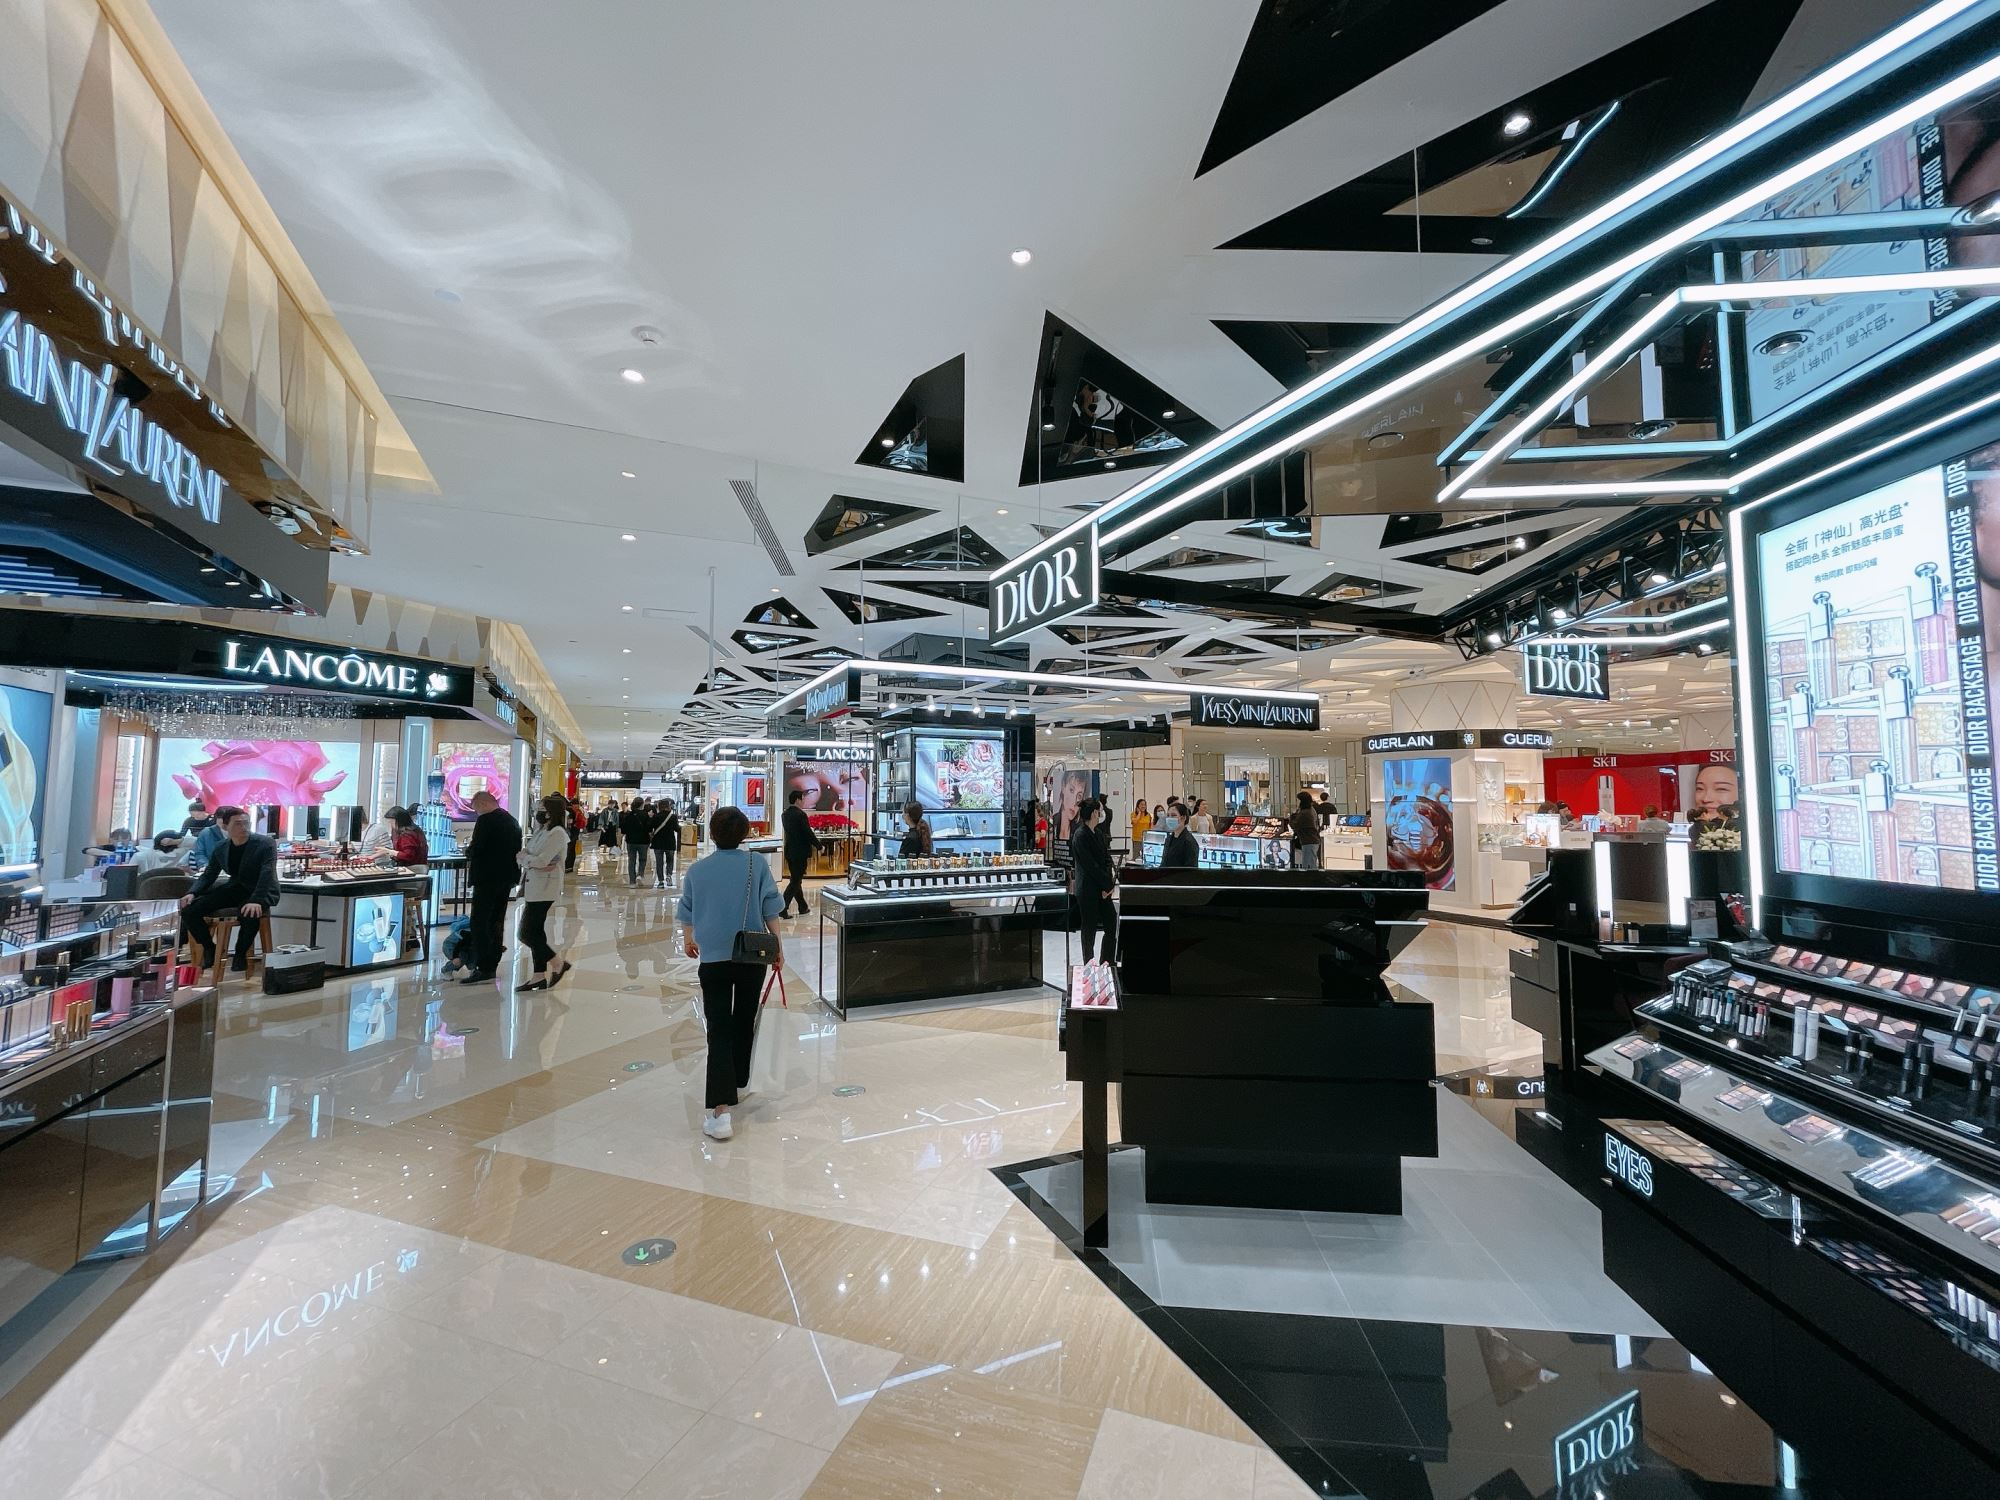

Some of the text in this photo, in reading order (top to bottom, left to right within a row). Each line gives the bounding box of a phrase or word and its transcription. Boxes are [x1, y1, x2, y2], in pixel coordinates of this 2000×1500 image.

[1946, 460, 1969, 498] DIOR
[995, 547, 1082, 633] DIOR
[1949, 505, 1979, 626] DIOR BACKSTAGE
[224, 641, 417, 693] LANCÔME
[1536, 657, 1604, 695] DIOR
[1959, 635, 1989, 755] DIOR BACKSTAGE
[1368, 735, 1434, 750] GUERLAIN
[1593, 757, 1617, 768] SK-II
[586, 771, 624, 780] CHANEL
[1970, 767, 2000, 889] DIOR BACKSTAGE
[1605, 1132, 1653, 1196] EYES
